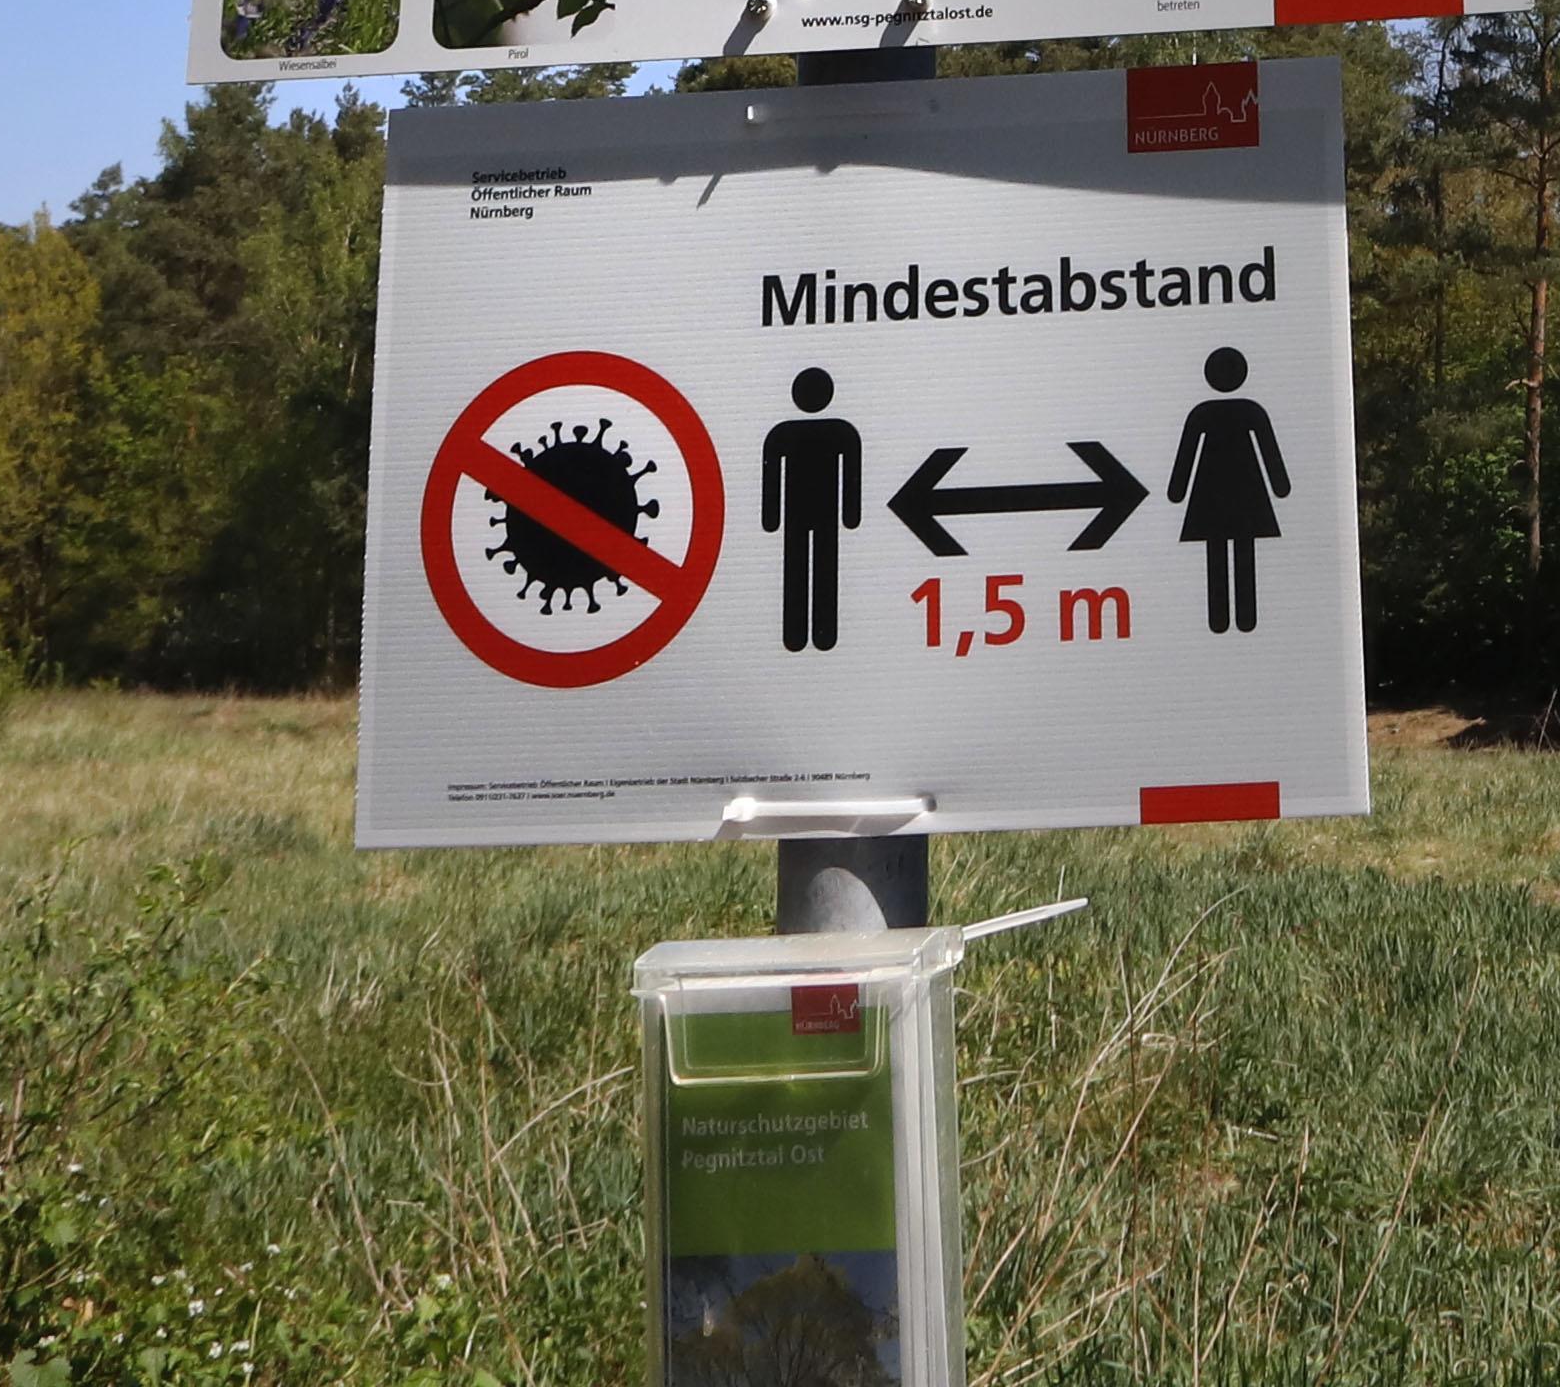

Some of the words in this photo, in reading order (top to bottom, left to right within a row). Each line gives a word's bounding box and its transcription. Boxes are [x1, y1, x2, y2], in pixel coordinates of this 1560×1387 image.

[1157, 0, 1200, 11] betreten
[508, 48, 529, 59] Pirol
[279, 59, 337, 71] Wiesensalbei
[471, 167, 567, 184] Servicebetrieb
[471, 184, 551, 201] Öffentlicher
[554, 185, 592, 197] Raum
[470, 205, 533, 219] Nürnberg
[762, 246, 1275, 327] Mindestabstand
[909, 575, 1025, 657] 1,5
[1059, 587, 1131, 641] m
[683, 1111, 868, 1136] Naturschutzgebiet
[682, 1146, 783, 1173] Pegnitztal
[791, 1145, 824, 1164] Ost
